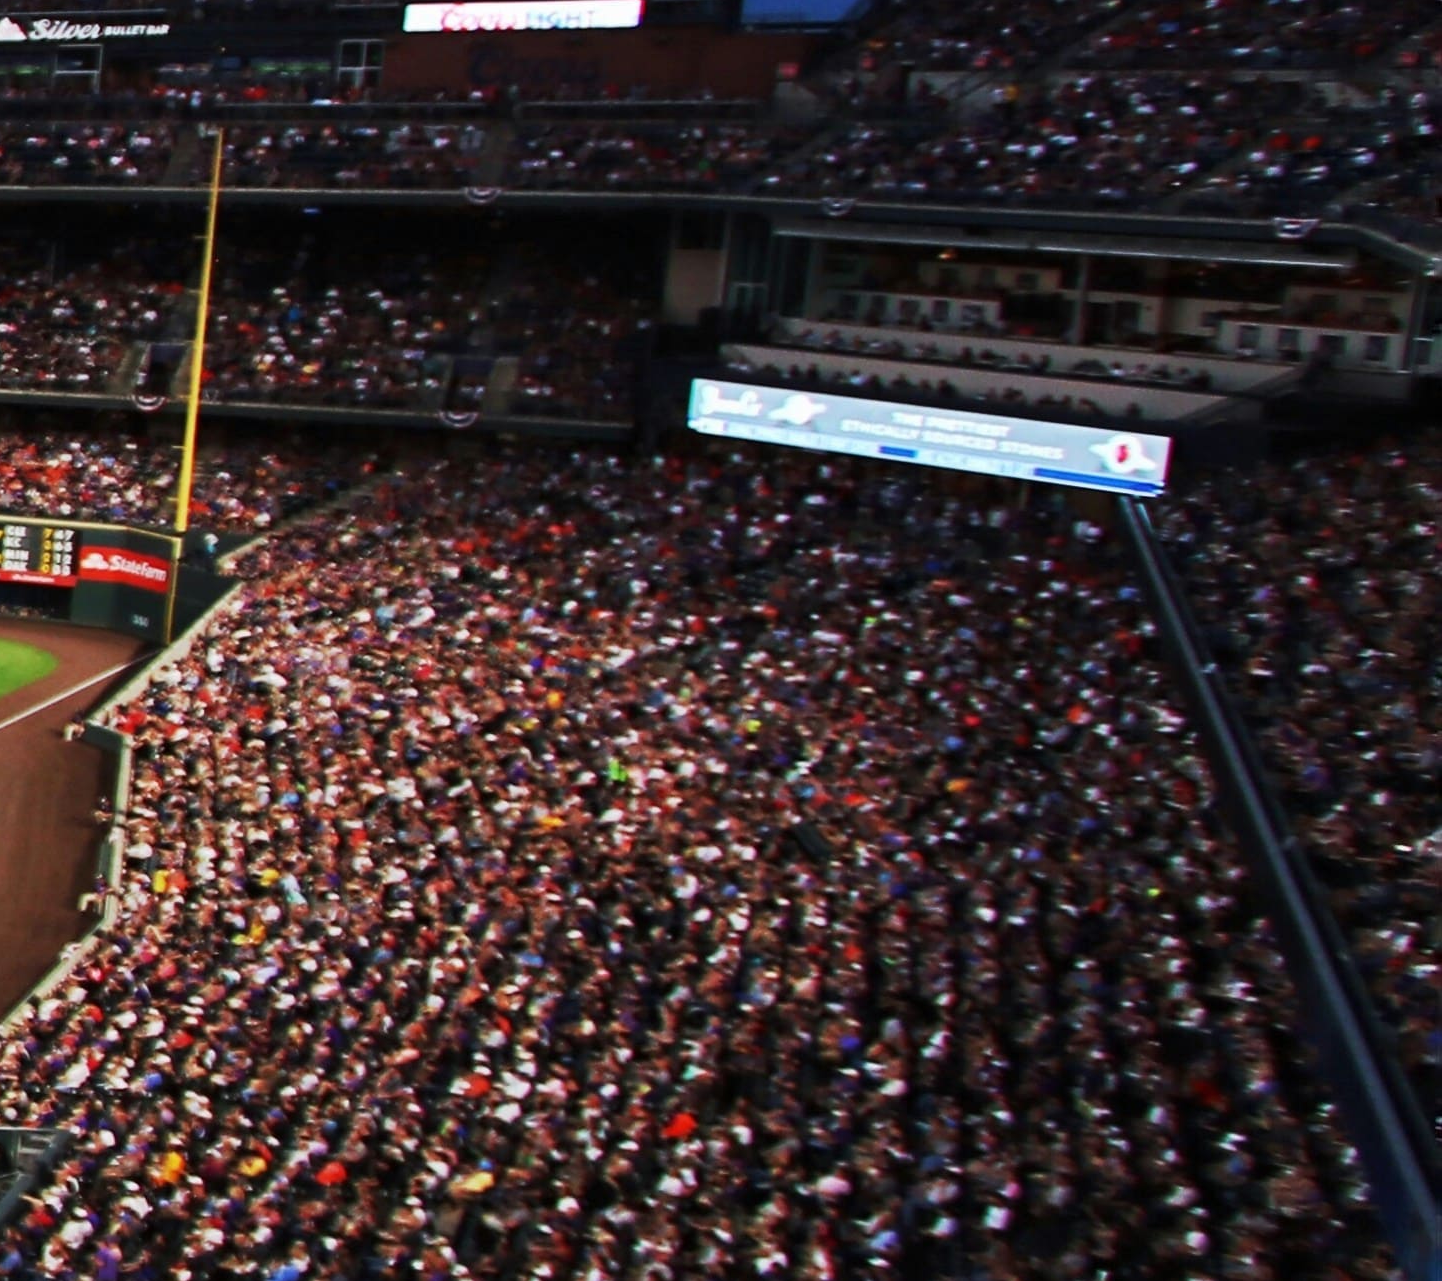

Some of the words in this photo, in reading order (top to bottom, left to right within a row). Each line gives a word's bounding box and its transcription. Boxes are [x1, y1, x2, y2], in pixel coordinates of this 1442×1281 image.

[29, 19, 102, 40] Silver
[105, 25, 145, 36] BULLET
[147, 24, 170, 35] BAR
